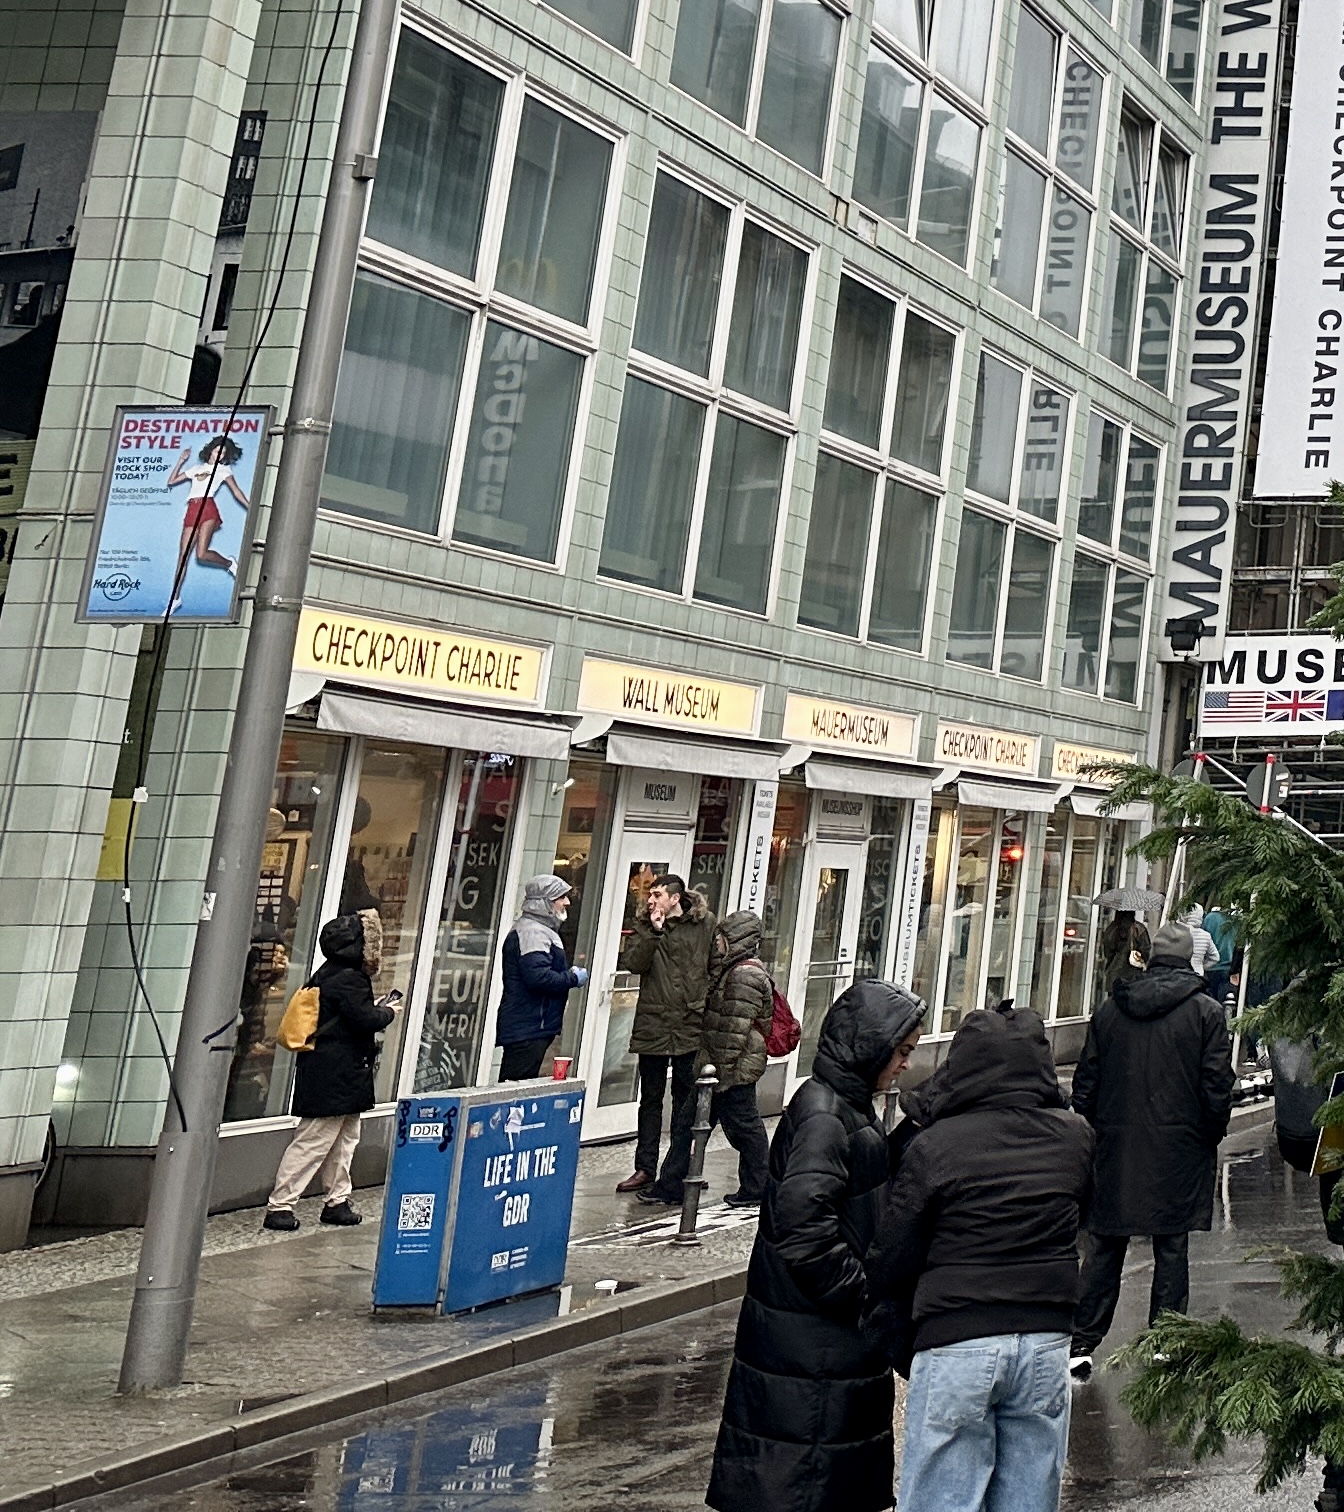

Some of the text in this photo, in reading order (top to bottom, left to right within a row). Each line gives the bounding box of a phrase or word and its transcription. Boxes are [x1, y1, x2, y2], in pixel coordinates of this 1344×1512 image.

[1211, 50, 1269, 144] THE
[1165, 174, 1259, 637] MAUERMUSEUM
[1304, 309, 1343, 469] CHARLIE
[120, 436, 182, 449] STYLE
[123, 419, 260, 434] DESTINATION
[115, 464, 141, 472] ROCK
[117, 456, 163, 464] VISIT OUR
[93, 579, 141, 590] Hard Rock
[312, 622, 523, 691] CHECKPOINT CHARLIE
[622, 676, 721, 721] WALL MUSEUM
[810, 708, 889, 747] MAUERMUSEUM
[942, 729, 1028, 767] CHECKPOINT CHARLIE
[644, 782, 677, 802] MUSEUM
[413, 1125, 439, 1136] DDR
[484, 1146, 558, 1188] LIFE IN THE
[502, 1193, 530, 1227] GDR
